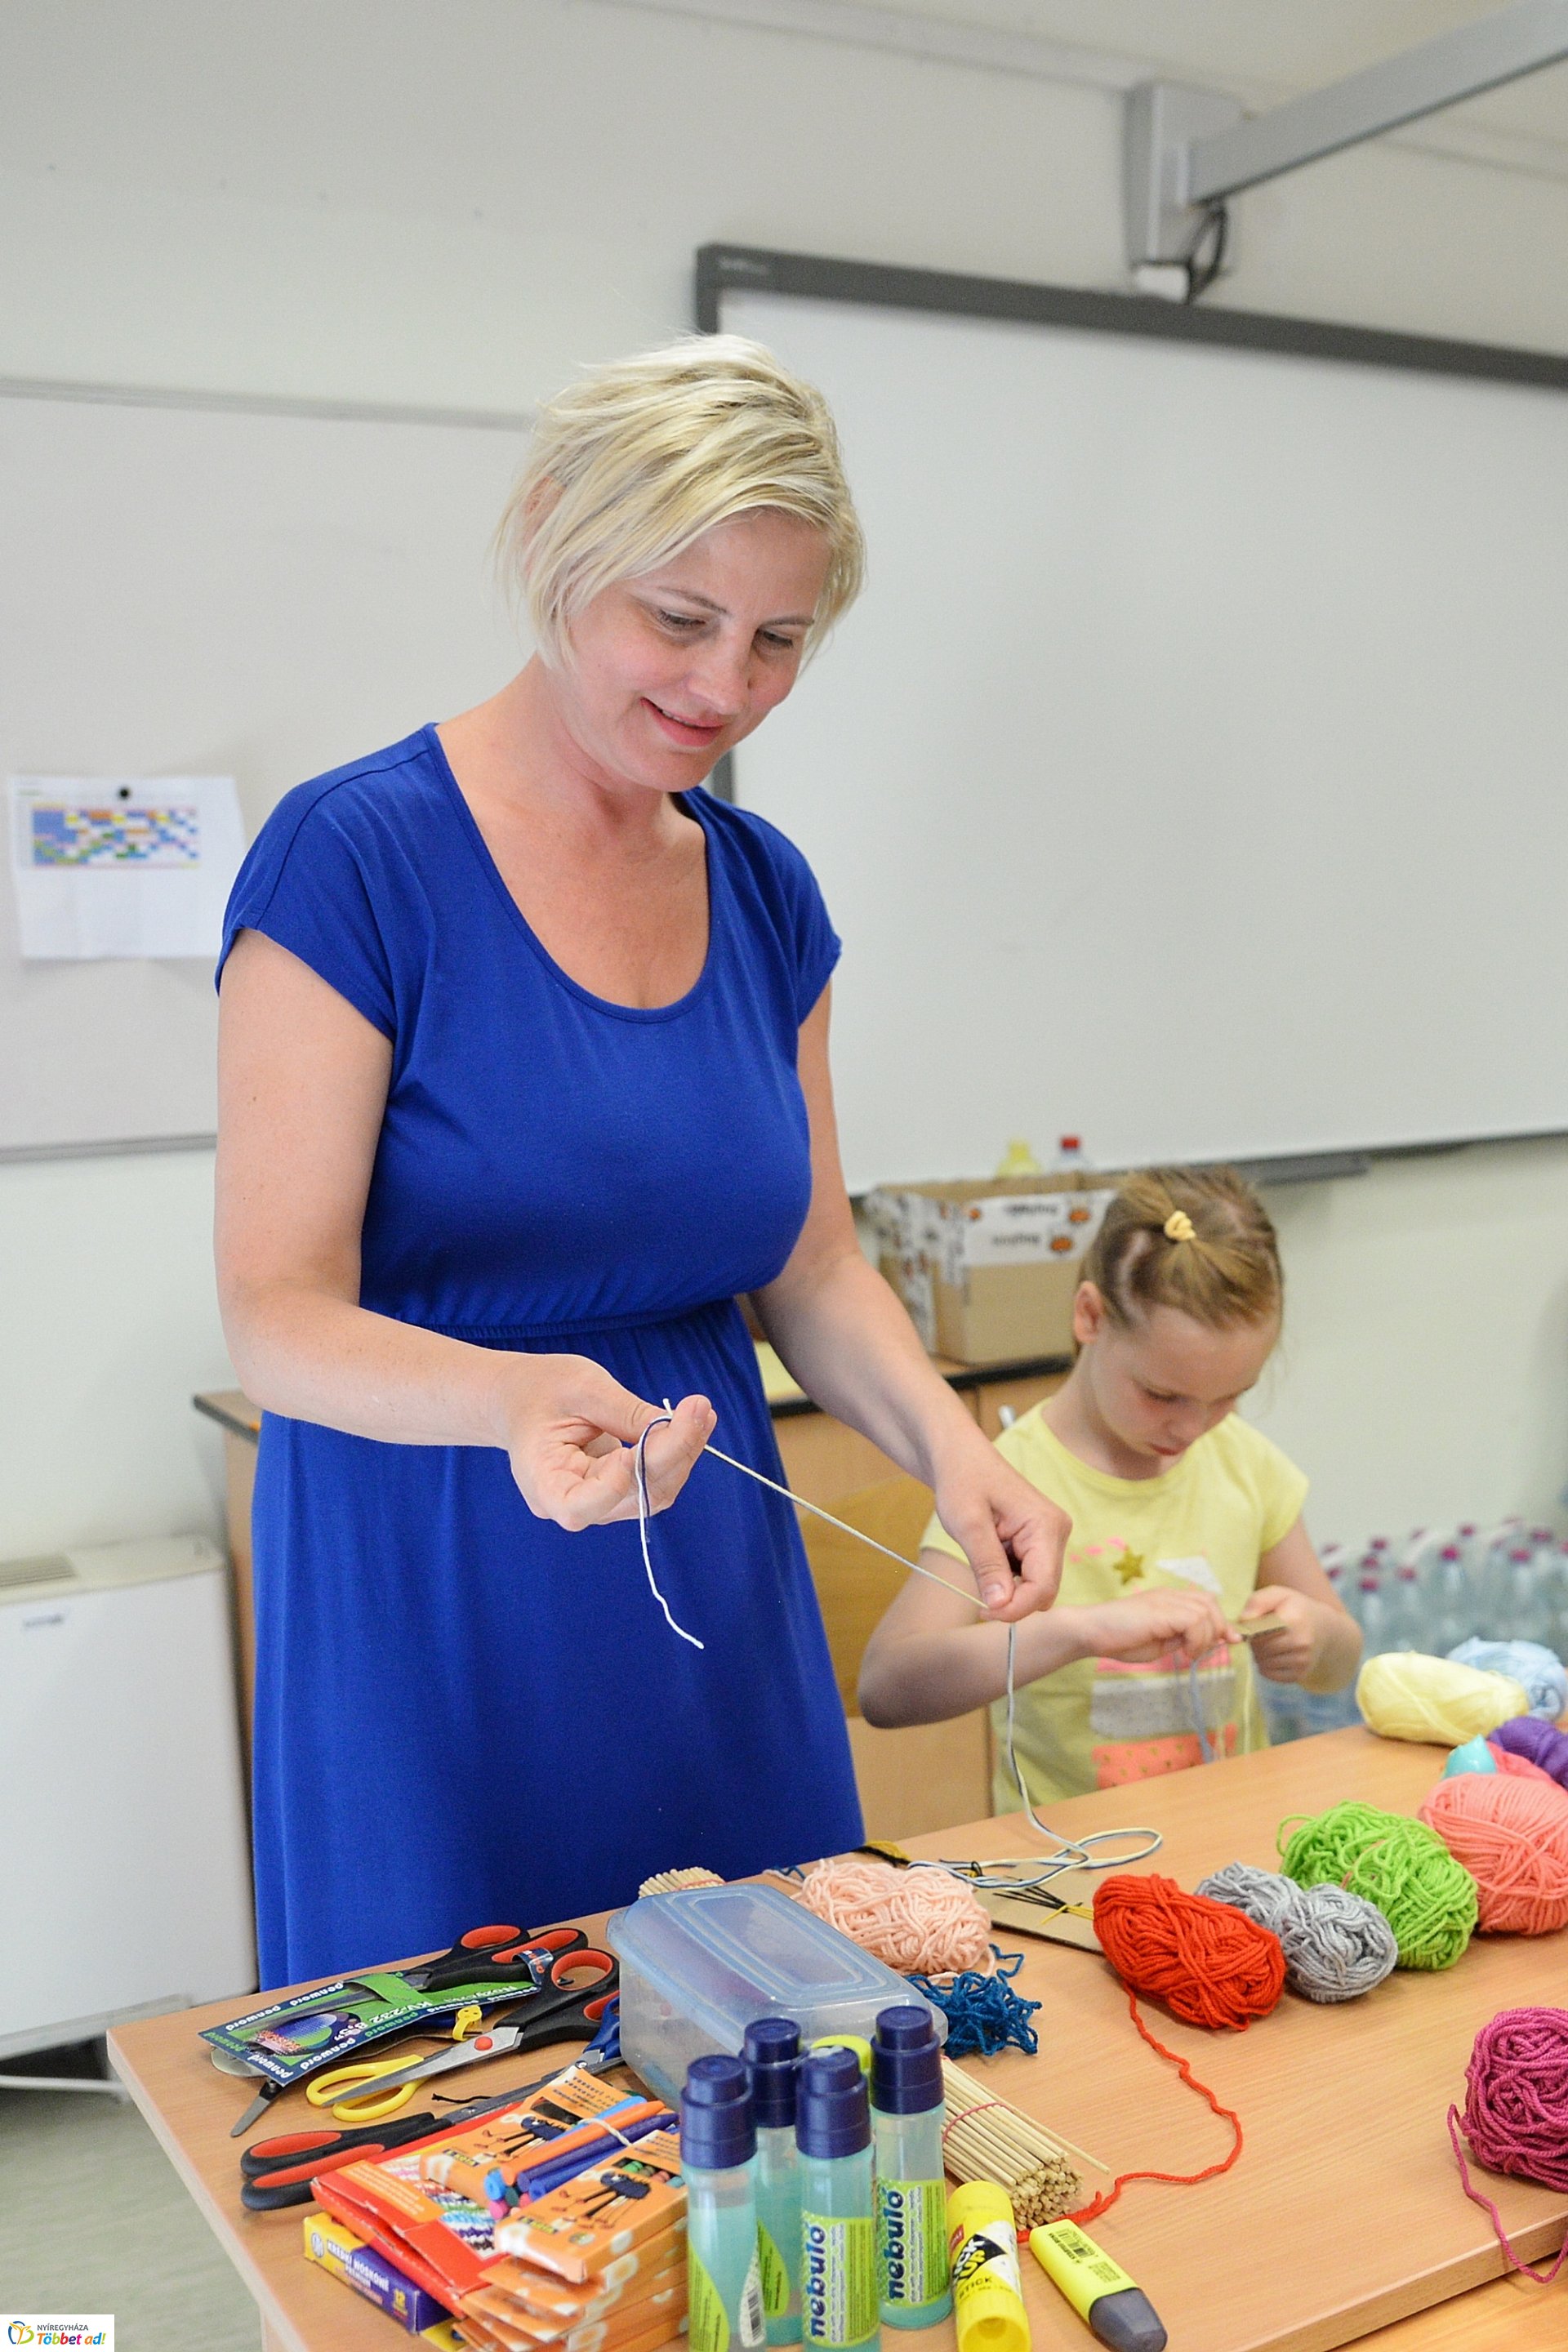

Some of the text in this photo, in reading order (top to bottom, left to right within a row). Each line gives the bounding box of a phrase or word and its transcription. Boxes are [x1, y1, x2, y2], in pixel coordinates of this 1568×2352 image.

[225, 1980, 344, 2031] penword penword
[369, 2001, 433, 2024] KV-232
[247, 2053, 294, 2079] penword
[300, 2038, 356, 2070] penword
[881, 2187, 905, 2299] nebuló
[804, 2221, 826, 2336] nebuló
